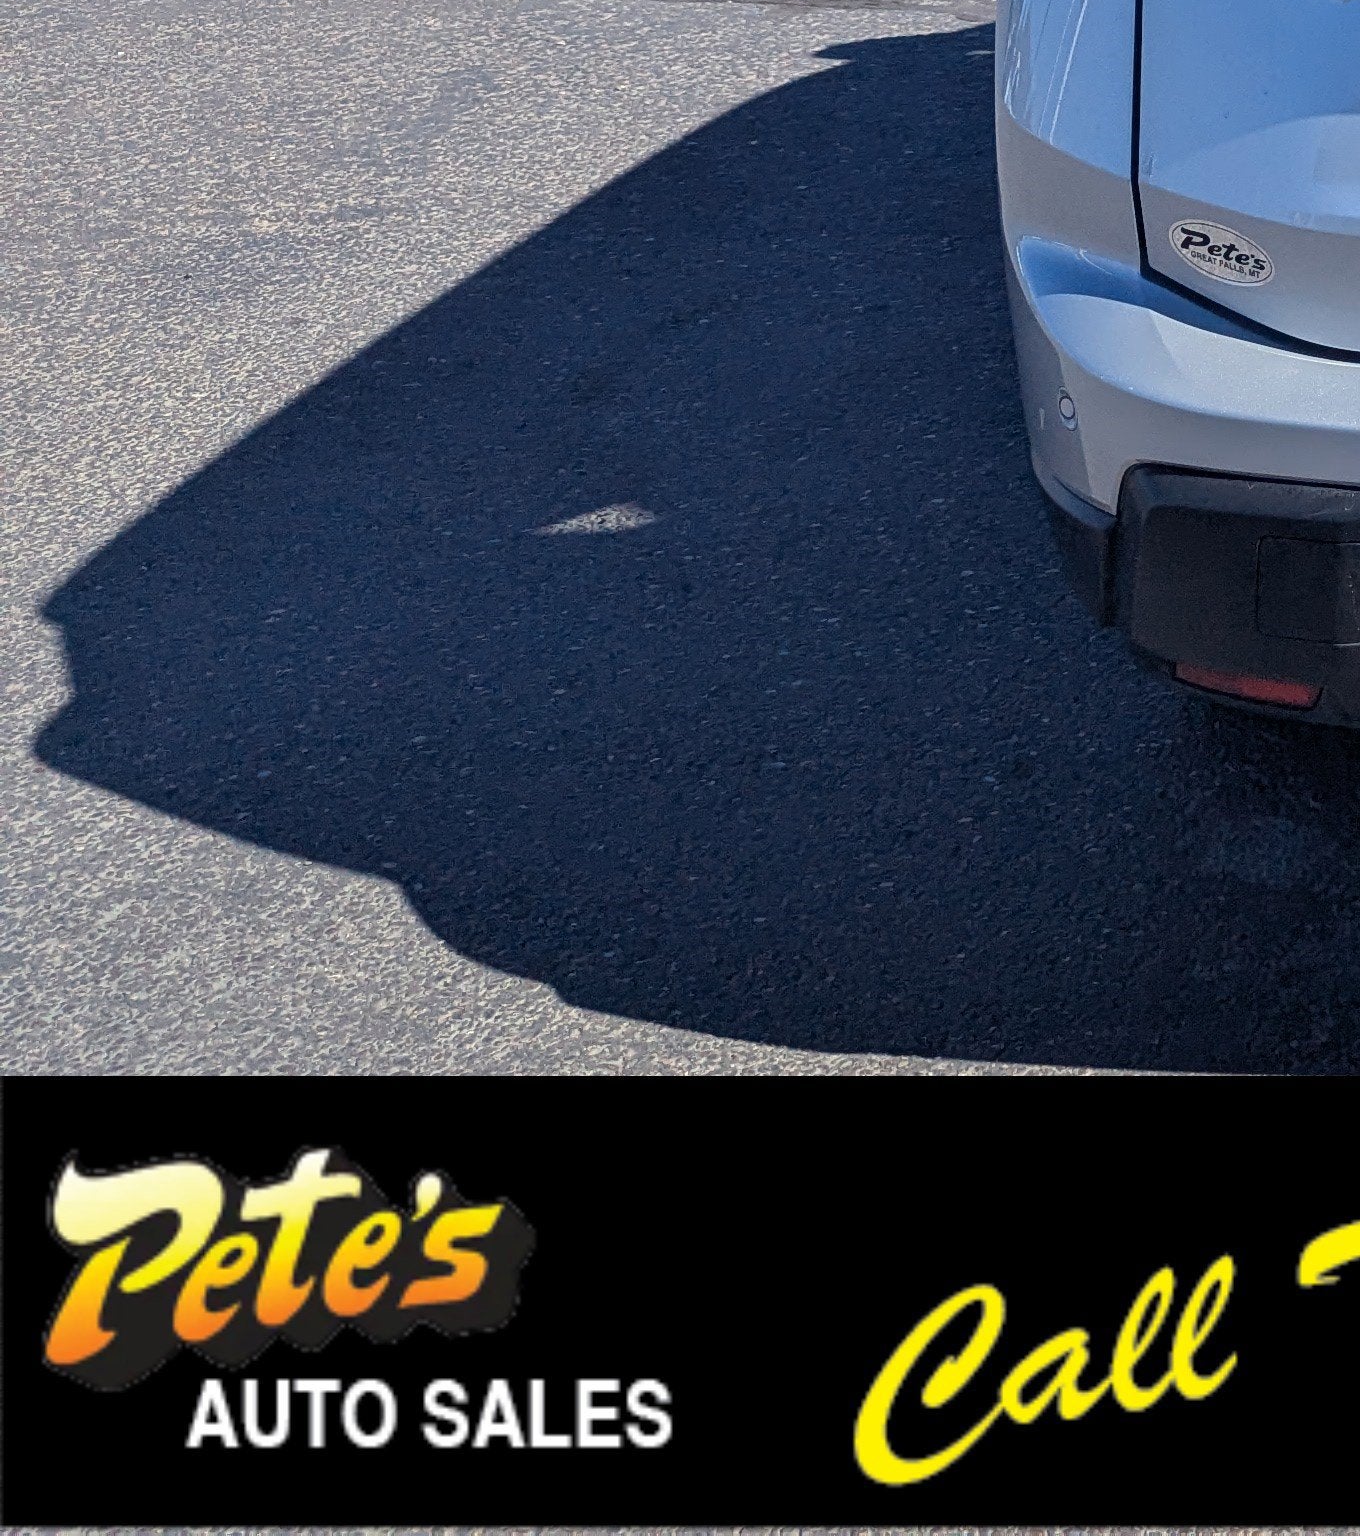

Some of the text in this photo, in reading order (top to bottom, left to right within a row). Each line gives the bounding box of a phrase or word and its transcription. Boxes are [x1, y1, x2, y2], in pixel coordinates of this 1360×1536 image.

[1180, 226, 1267, 272] Pete's
[1190, 249, 1217, 265] GREAT
[1248, 268, 1261, 279] MT
